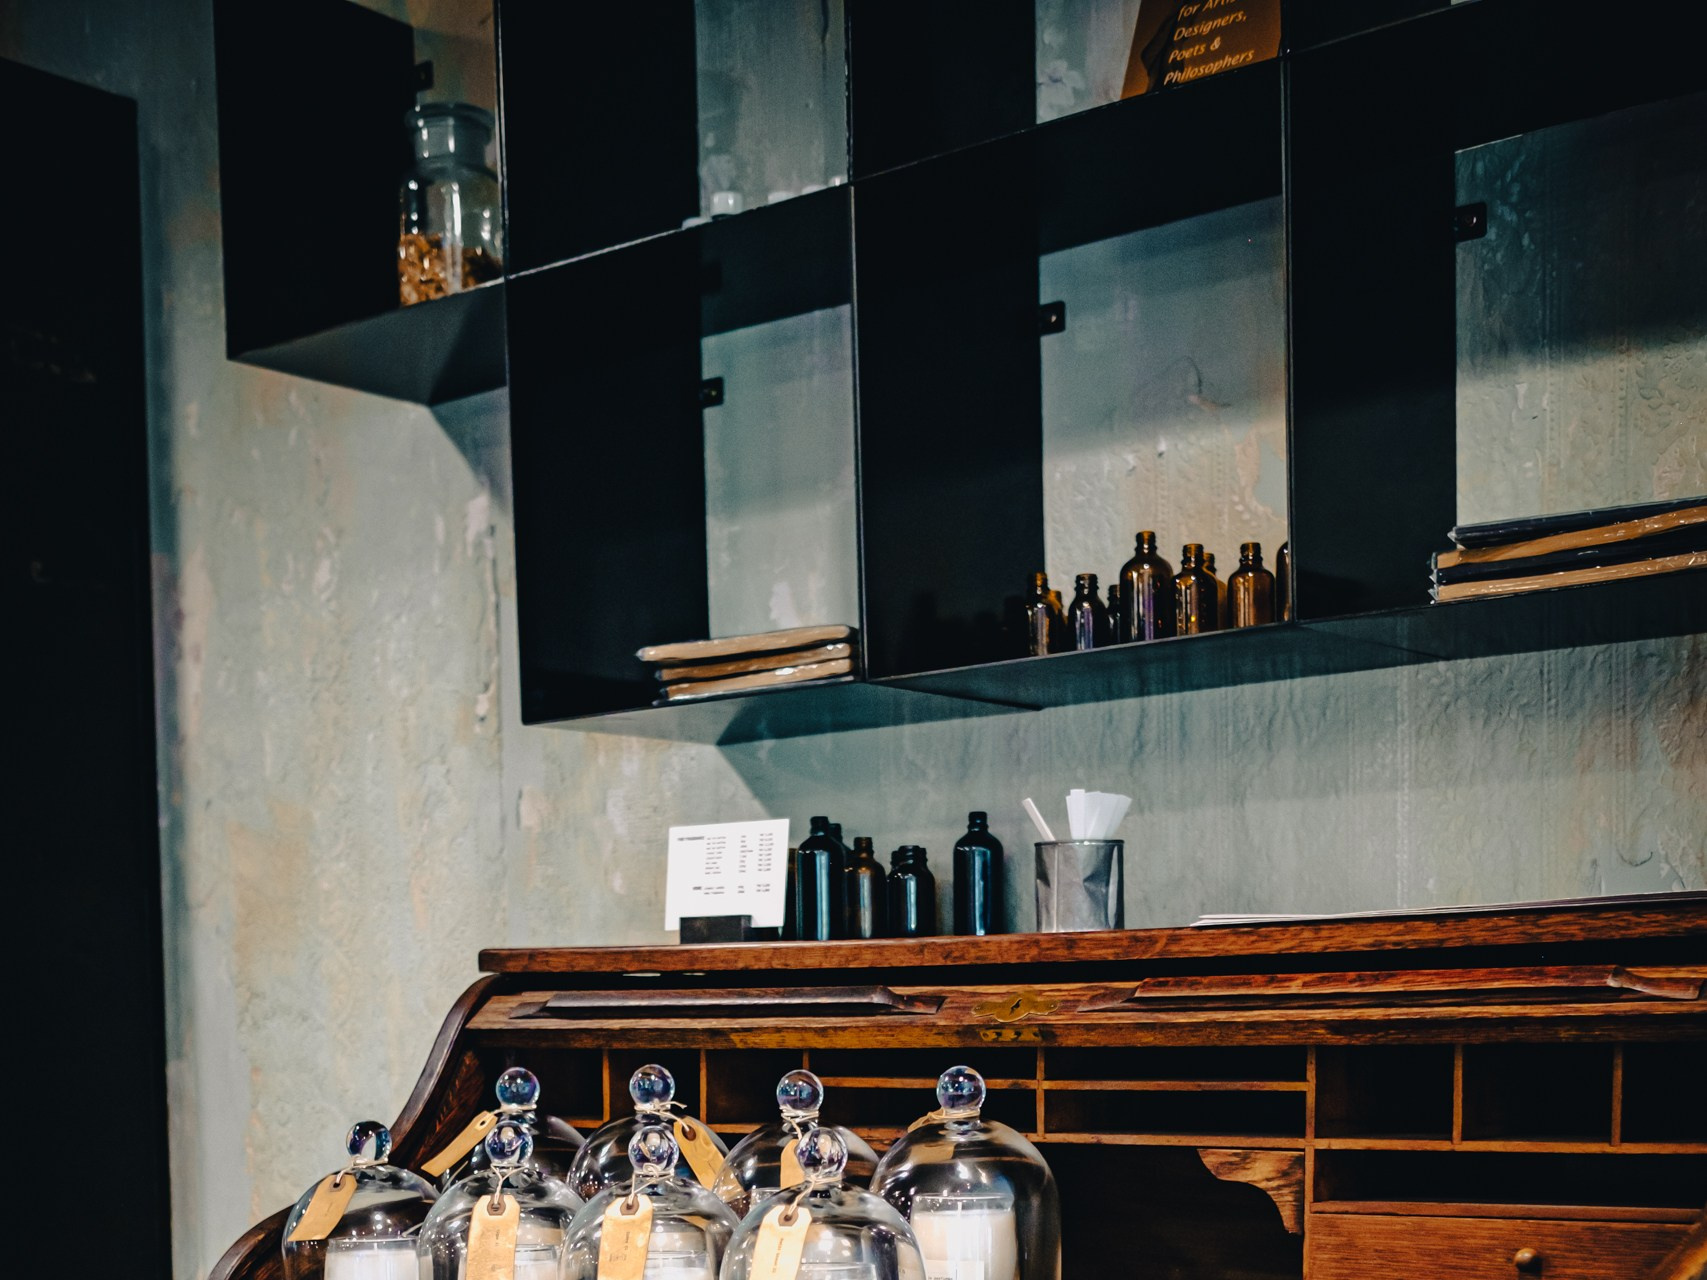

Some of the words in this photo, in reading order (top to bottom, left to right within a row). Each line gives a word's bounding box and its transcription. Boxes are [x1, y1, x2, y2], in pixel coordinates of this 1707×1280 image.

[1173, 10, 1247, 41] Designers,
[1178, 4, 1200, 21] for
[1168, 43, 1206, 64] Poets
[1209, 36, 1221, 50] &
[1163, 49, 1255, 86] Philosophers
